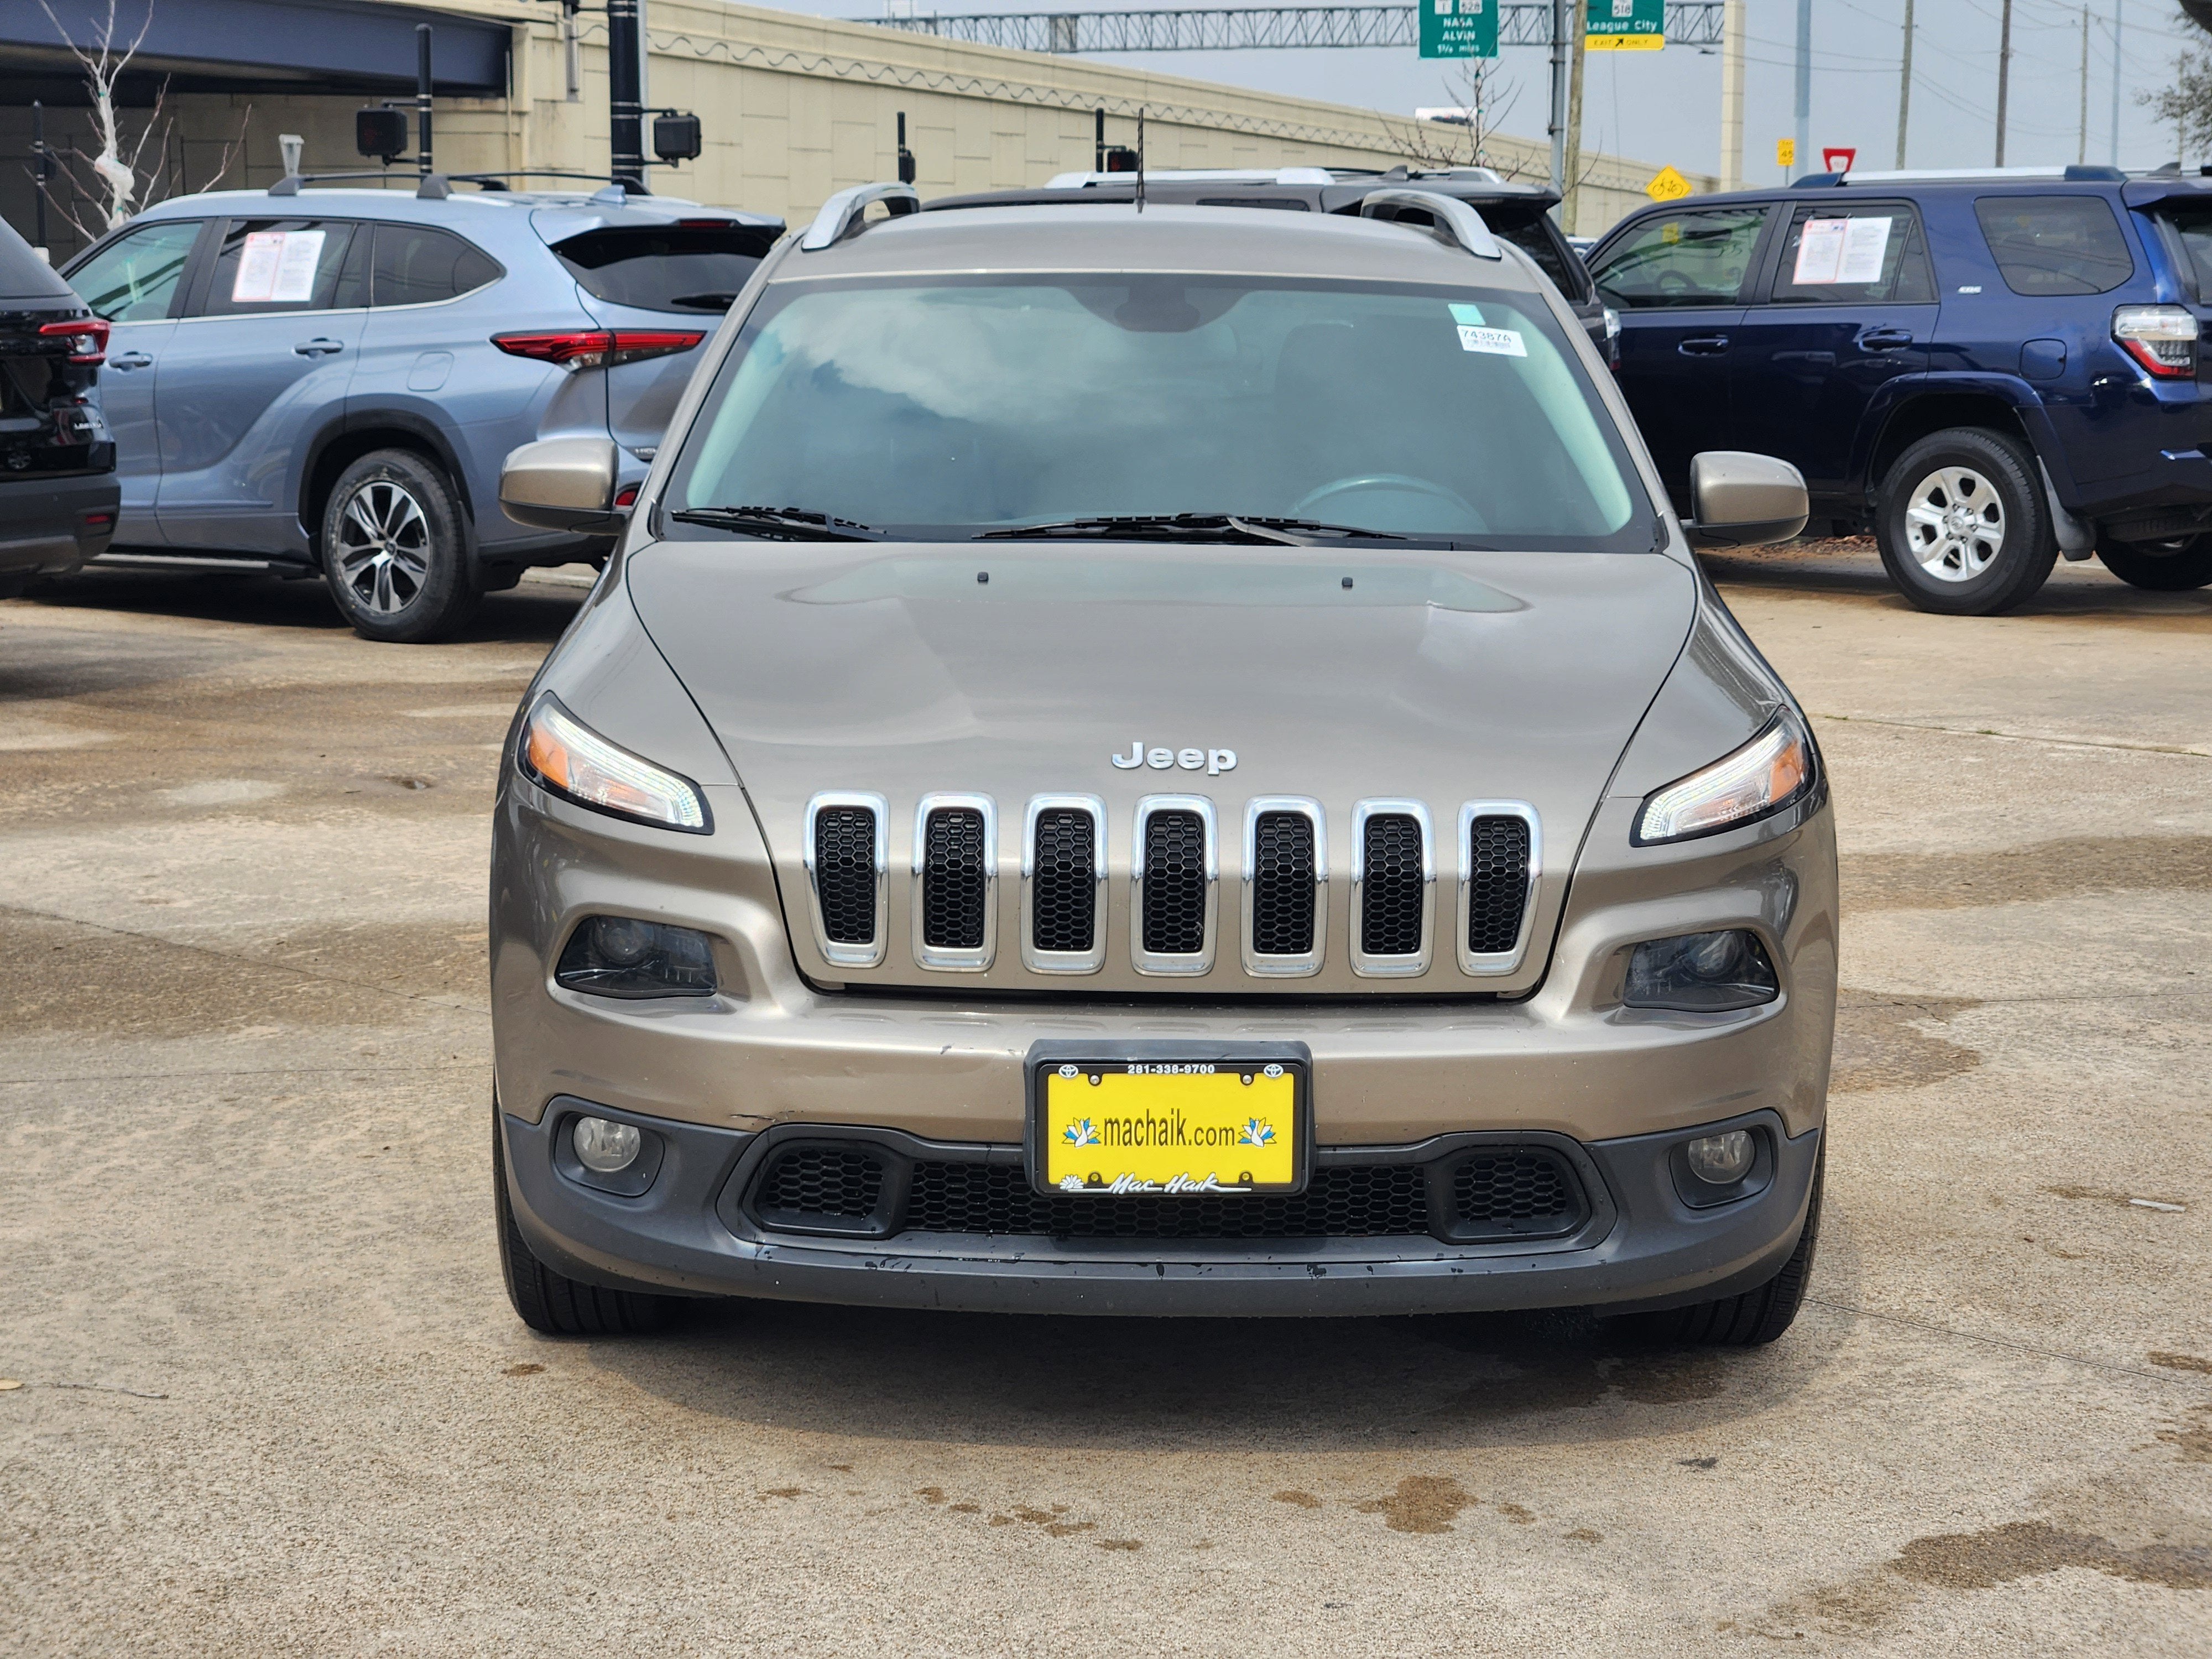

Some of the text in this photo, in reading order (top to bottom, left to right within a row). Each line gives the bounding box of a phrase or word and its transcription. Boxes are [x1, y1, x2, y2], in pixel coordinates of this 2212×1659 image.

[1443, 17, 1474, 28] NASA
[1587, 19, 1658, 33] League City
[1442, 30, 1475, 41] ALVIN
[1111, 742, 1238, 776] Jeep
[1127, 1063, 1215, 1074] 281-338-9700
[1104, 1108, 1235, 1147] machaik.com
[1108, 1171, 1223, 1194] Mac Haik
